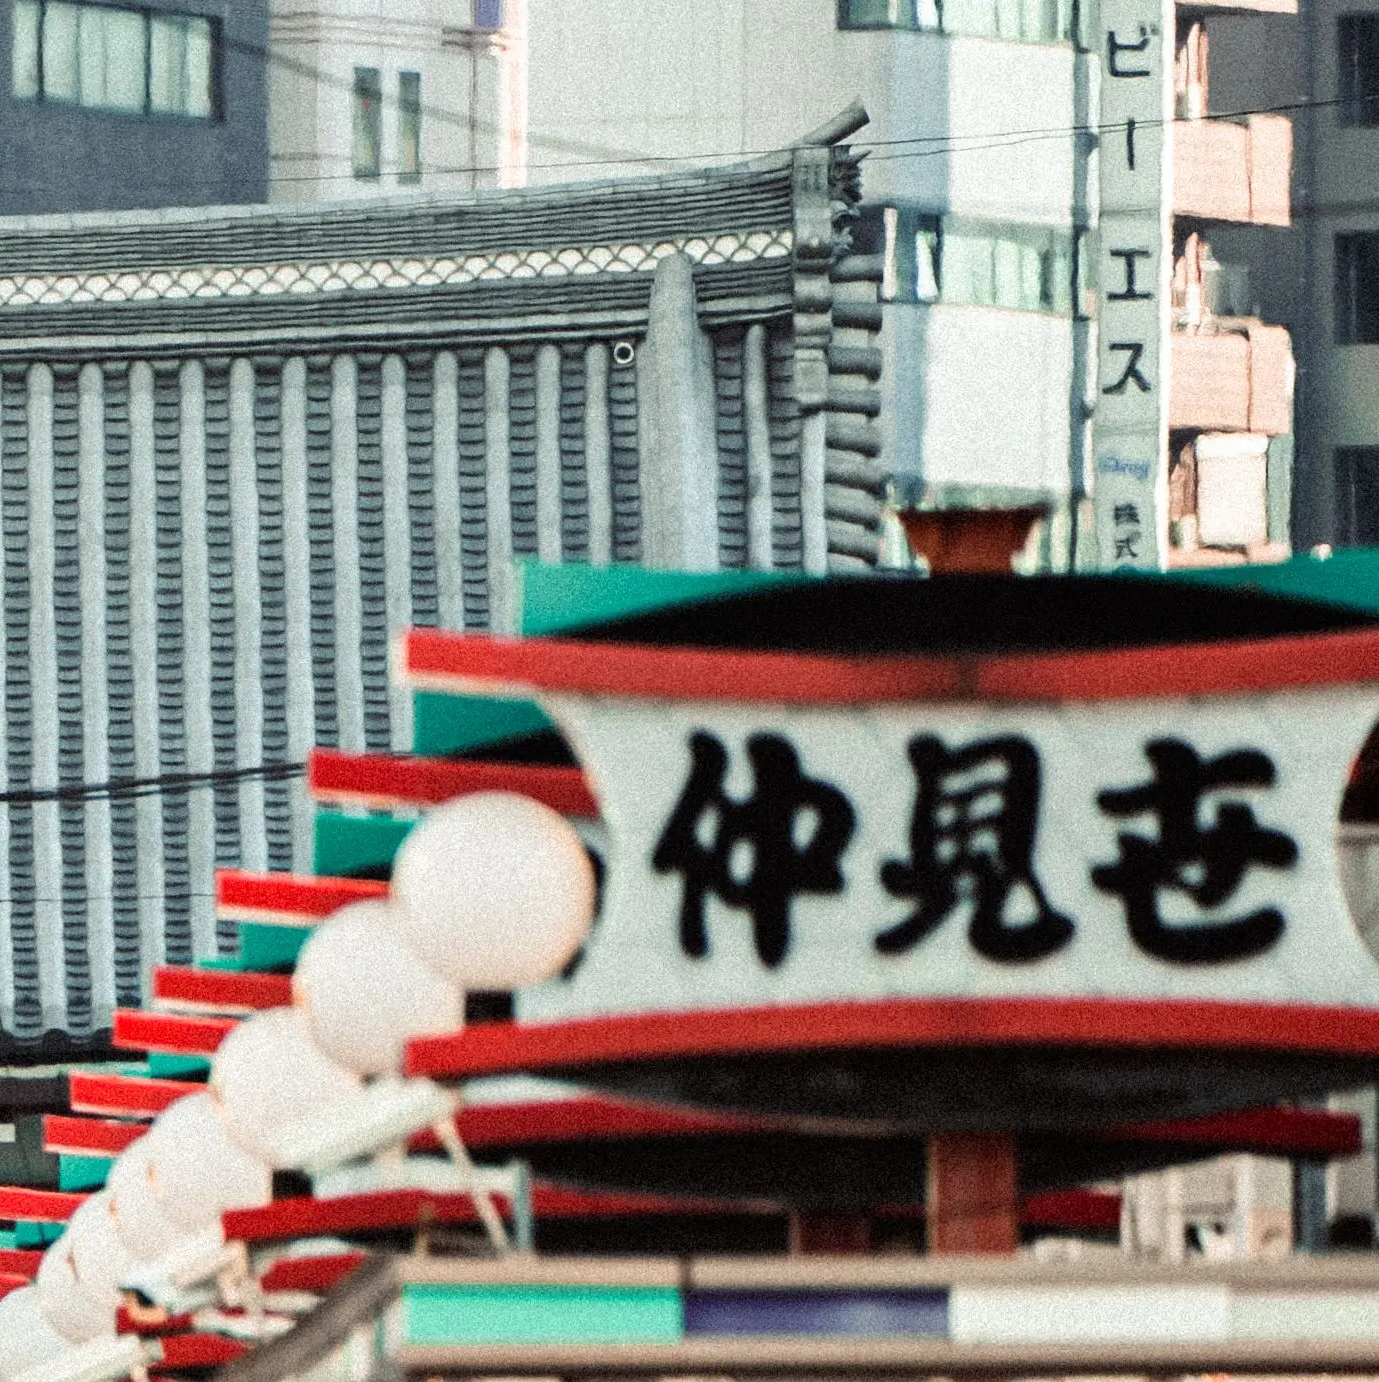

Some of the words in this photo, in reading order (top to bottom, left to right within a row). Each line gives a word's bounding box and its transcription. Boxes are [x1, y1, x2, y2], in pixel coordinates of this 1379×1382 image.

[1103, 26, 1159, 394] ビーエス
[652, 728, 1299, 970] 仲見世
